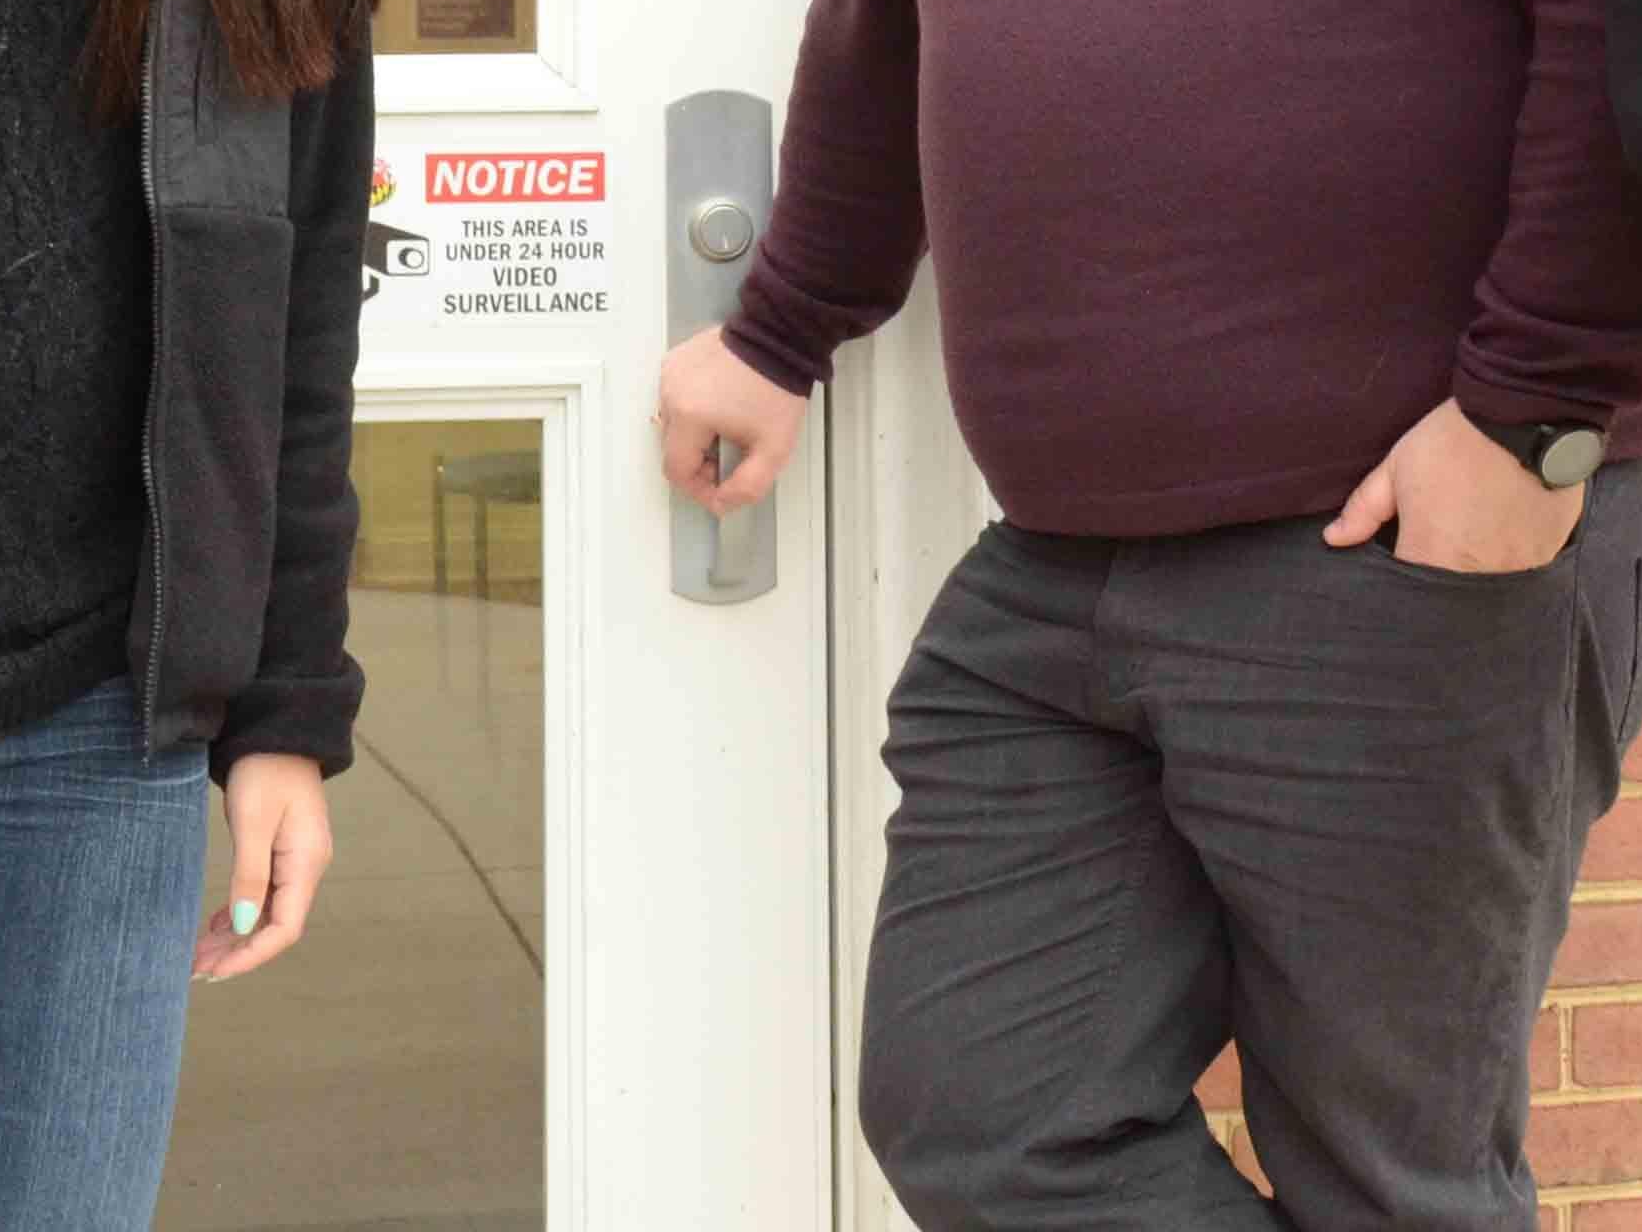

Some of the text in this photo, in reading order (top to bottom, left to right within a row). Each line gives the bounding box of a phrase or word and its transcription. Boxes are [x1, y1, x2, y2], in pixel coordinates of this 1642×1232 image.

[433, 159, 598, 196] NOTICE
[461, 218, 588, 238] THIS AREA IS
[445, 241, 605, 261] UNDER 24 HOUR
[493, 266, 557, 287] VIDEO
[443, 291, 608, 314] SURVEILLANCE
